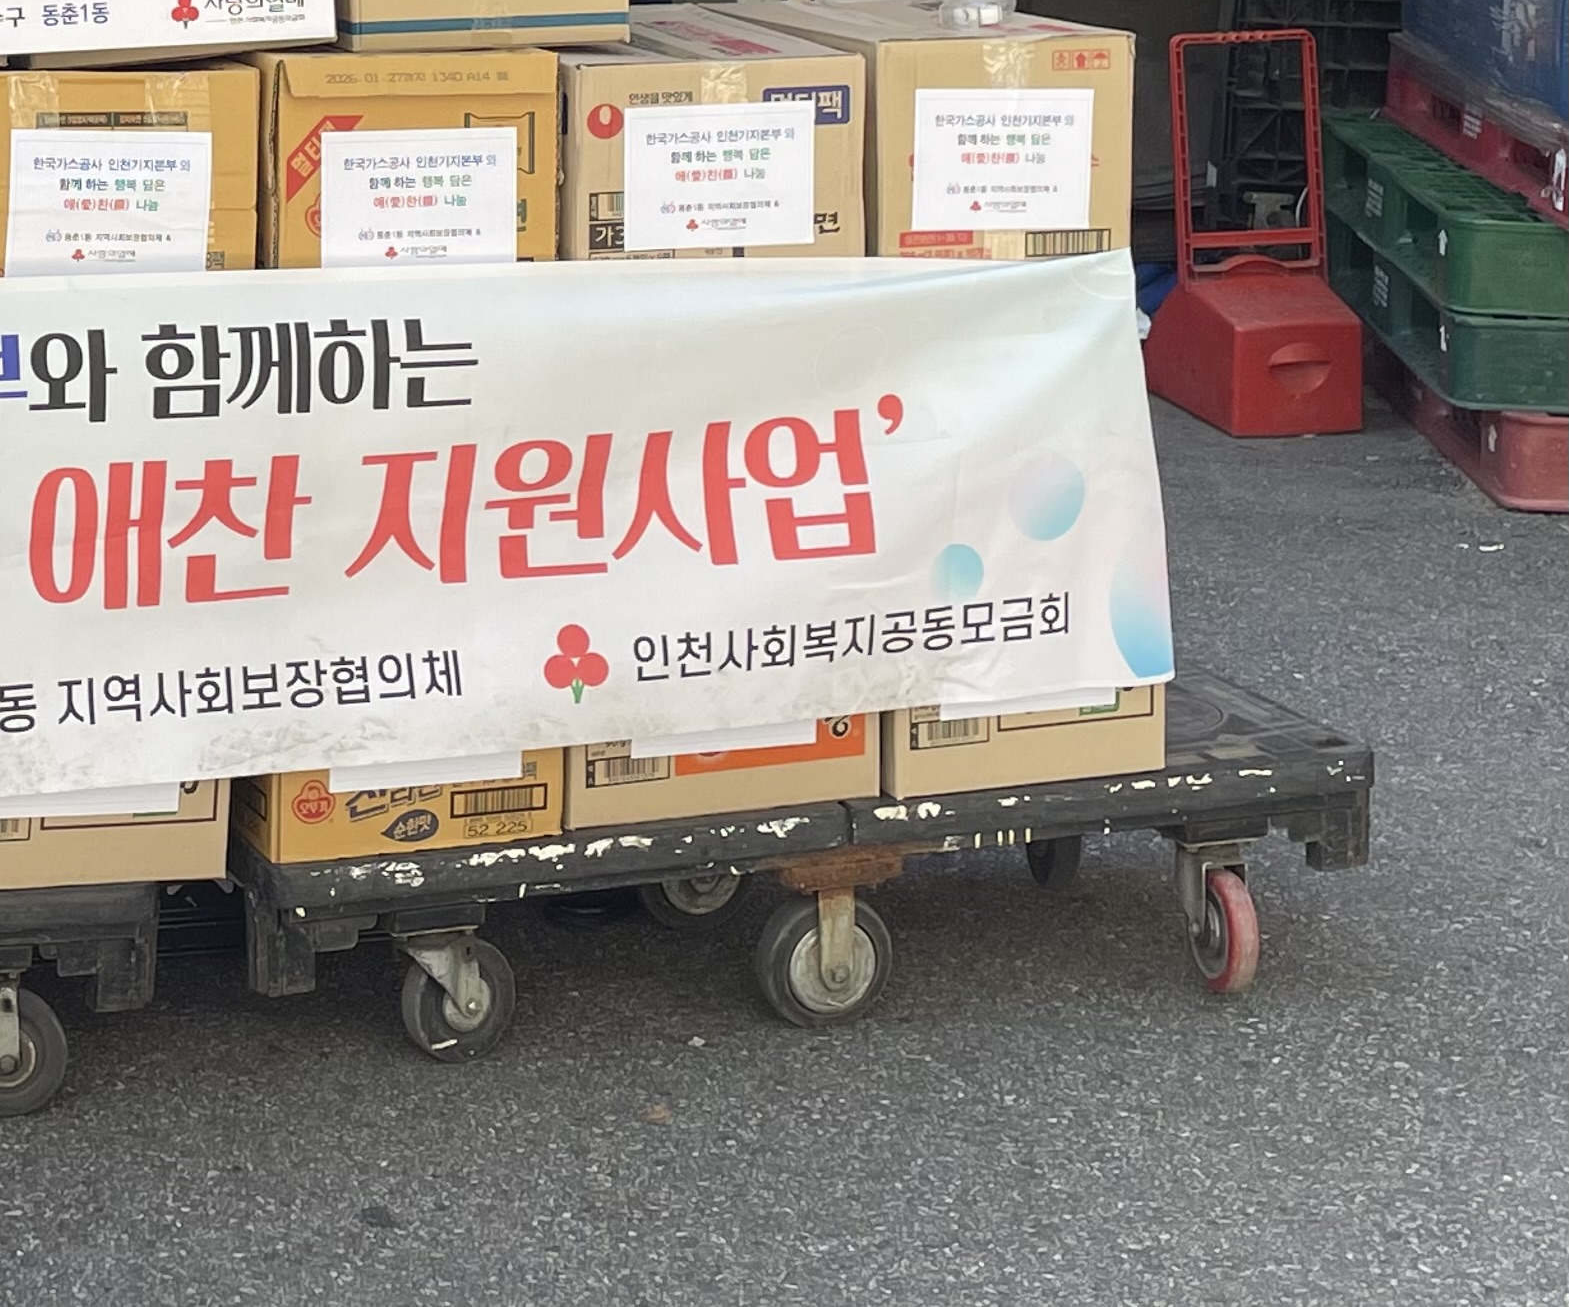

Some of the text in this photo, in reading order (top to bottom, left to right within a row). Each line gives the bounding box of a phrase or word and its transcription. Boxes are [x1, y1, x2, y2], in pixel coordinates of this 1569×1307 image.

[42, 2, 109, 26] 동춘1동
[935, 115, 1062, 127] 한국가스공사 인천기지본부
[646, 129, 781, 145] 한국가스공사 인천기지본부
[34, 157, 102, 171] 한국가스공사
[108, 159, 177, 172] 인천기지본부
[344, 157, 410, 170] 한국가스공사
[416, 155, 483, 168] 인천기지본부
[60, 178, 82, 191] 함께
[86, 179, 108, 191] 하는
[369, 177, 391, 189] 함께
[394, 176, 416, 188] 하는
[141, 319, 479, 419] 함께하는
[31, 455, 312, 610] 애찬
[634, 592, 1068, 681] 인천사회복지공동모금회
[58, 650, 462, 725] 지역사회보장협의체
[466, 820, 528, 838] 52 225
